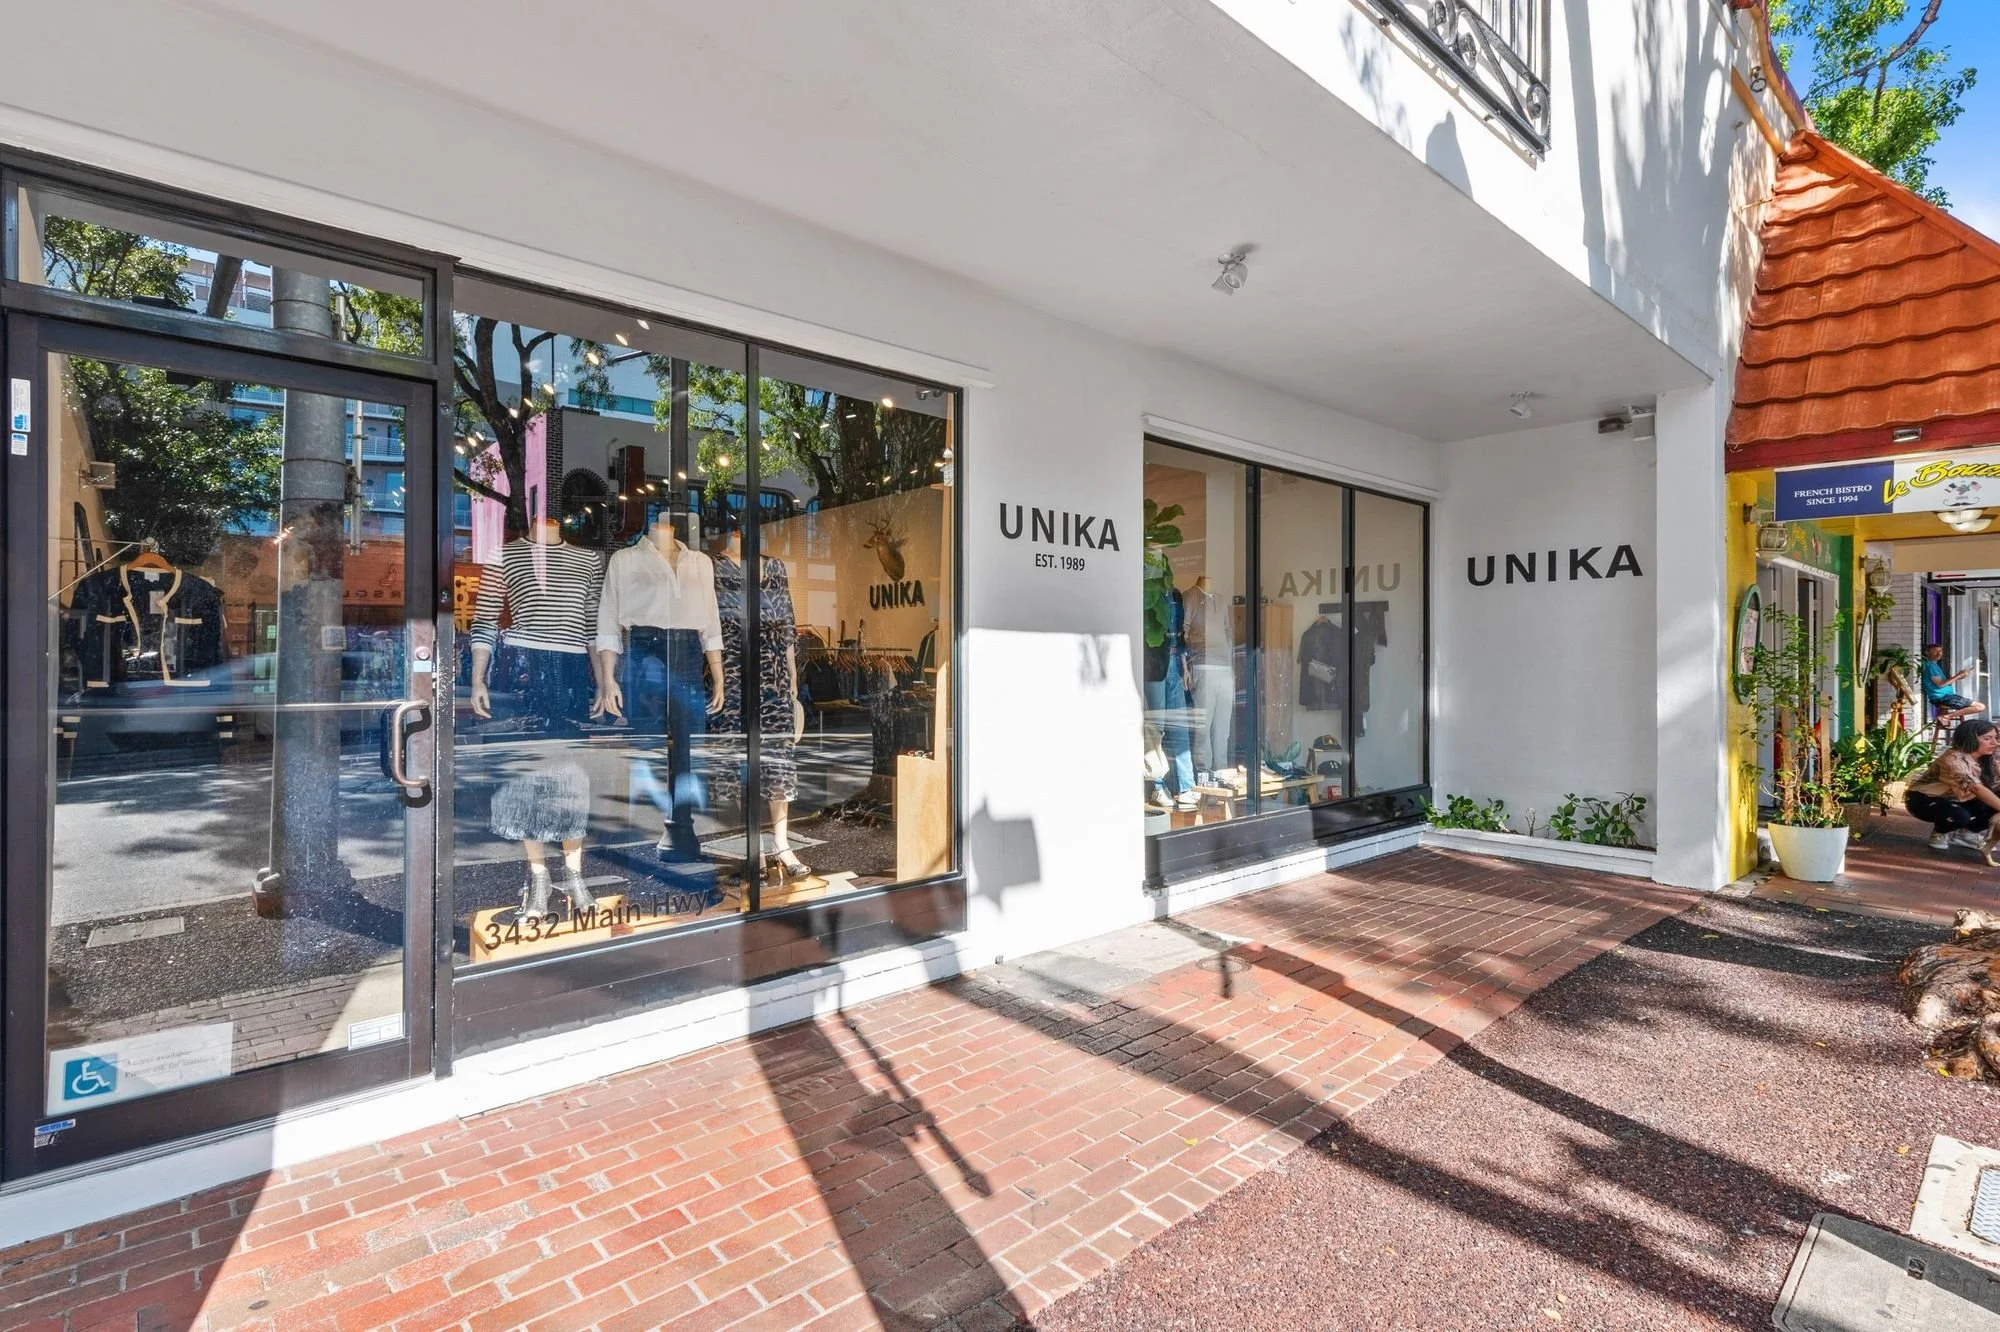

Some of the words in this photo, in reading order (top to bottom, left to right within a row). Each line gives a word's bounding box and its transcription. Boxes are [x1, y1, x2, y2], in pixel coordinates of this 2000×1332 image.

[1794, 487, 1833, 498] FRENCH
[1835, 484, 1873, 494] BISTRO
[1806, 497, 1836, 506] SINCE
[1838, 495, 1859, 503] 1994
[1883, 479, 1911, 505] Le
[1000, 502, 1120, 551] UNIKA
[1035, 553, 1058, 569] EST.
[1060, 556, 1085, 571] 1989
[1467, 544, 1644, 587] UNIKA
[869, 580, 926, 611] UNIKA
[484, 912, 561, 951] 3432
[573, 900, 641, 933] Main
[652, 890, 710, 917] Hwy
